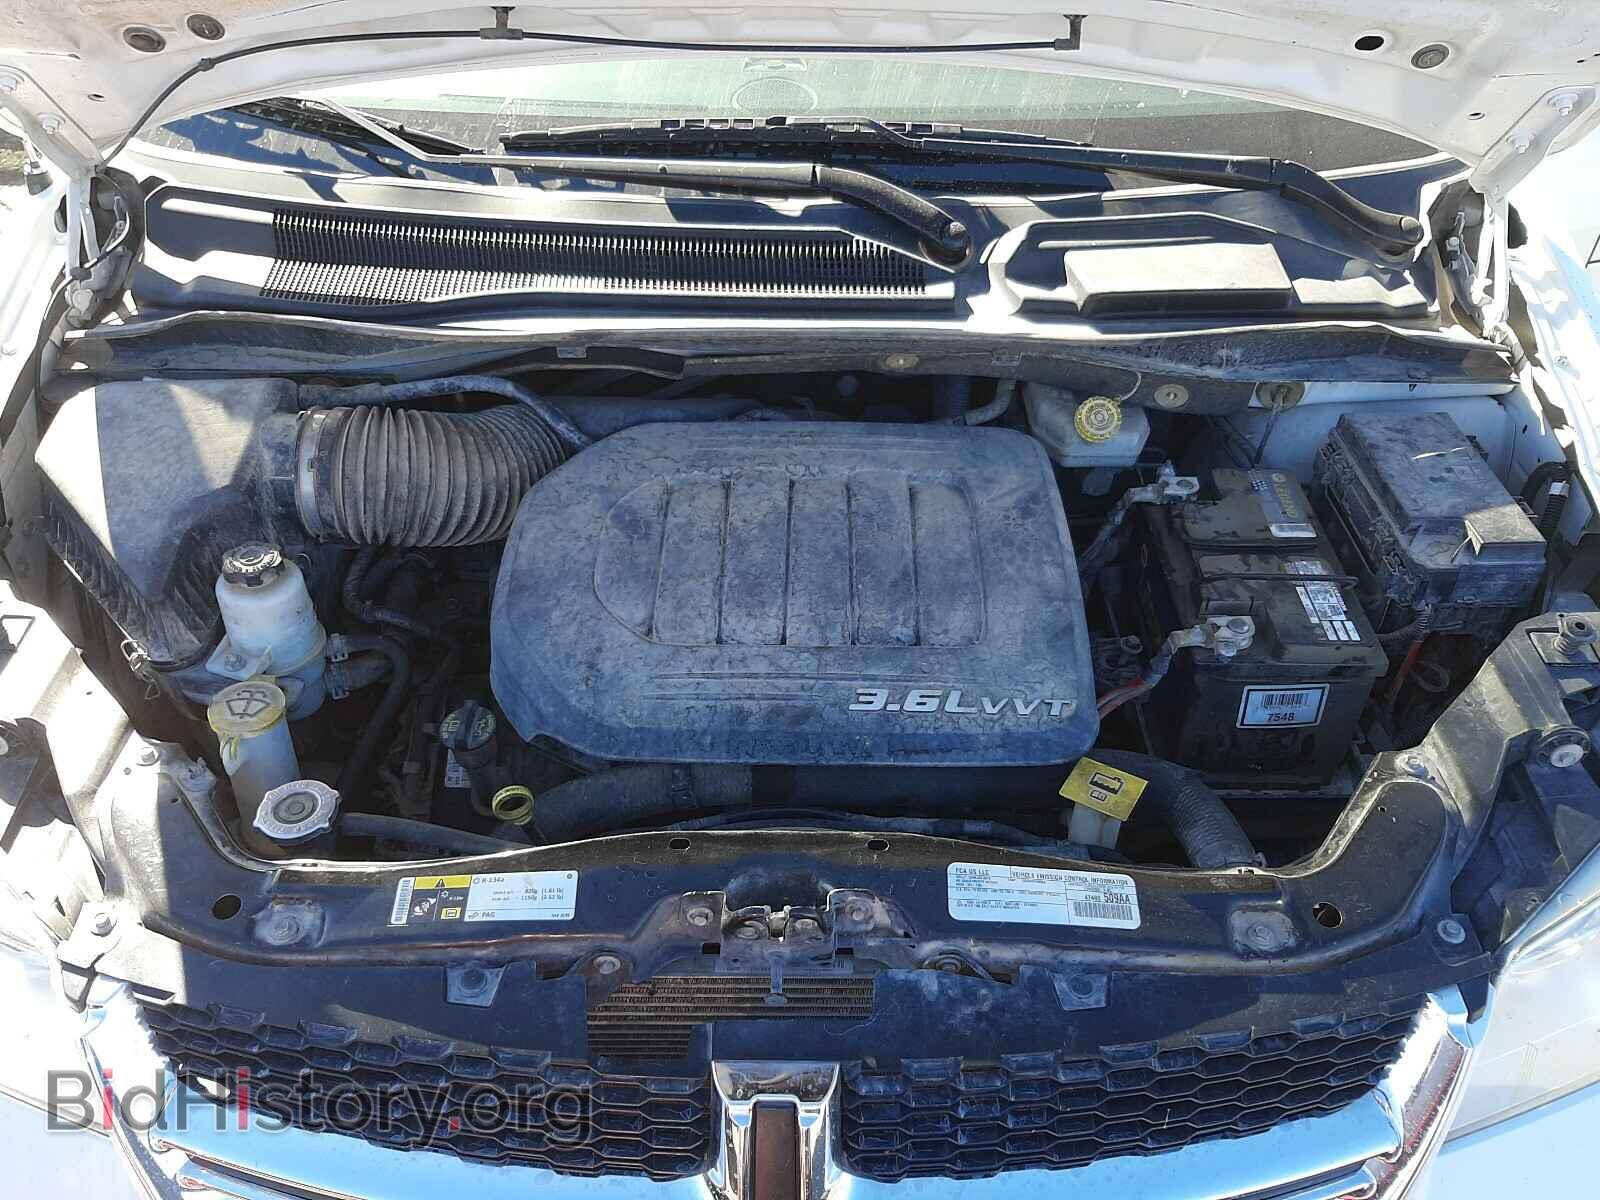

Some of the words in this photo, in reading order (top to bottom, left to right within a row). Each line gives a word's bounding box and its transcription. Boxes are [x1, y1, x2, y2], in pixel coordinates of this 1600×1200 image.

[1266, 712, 1295, 722] 7548
[1012, 871, 1035, 880] VEHICLE
[1036, 872, 1063, 881] EMISSION
[1064, 874, 1088, 884] CONTROL
[1090, 876, 1129, 886] INFORMATION
